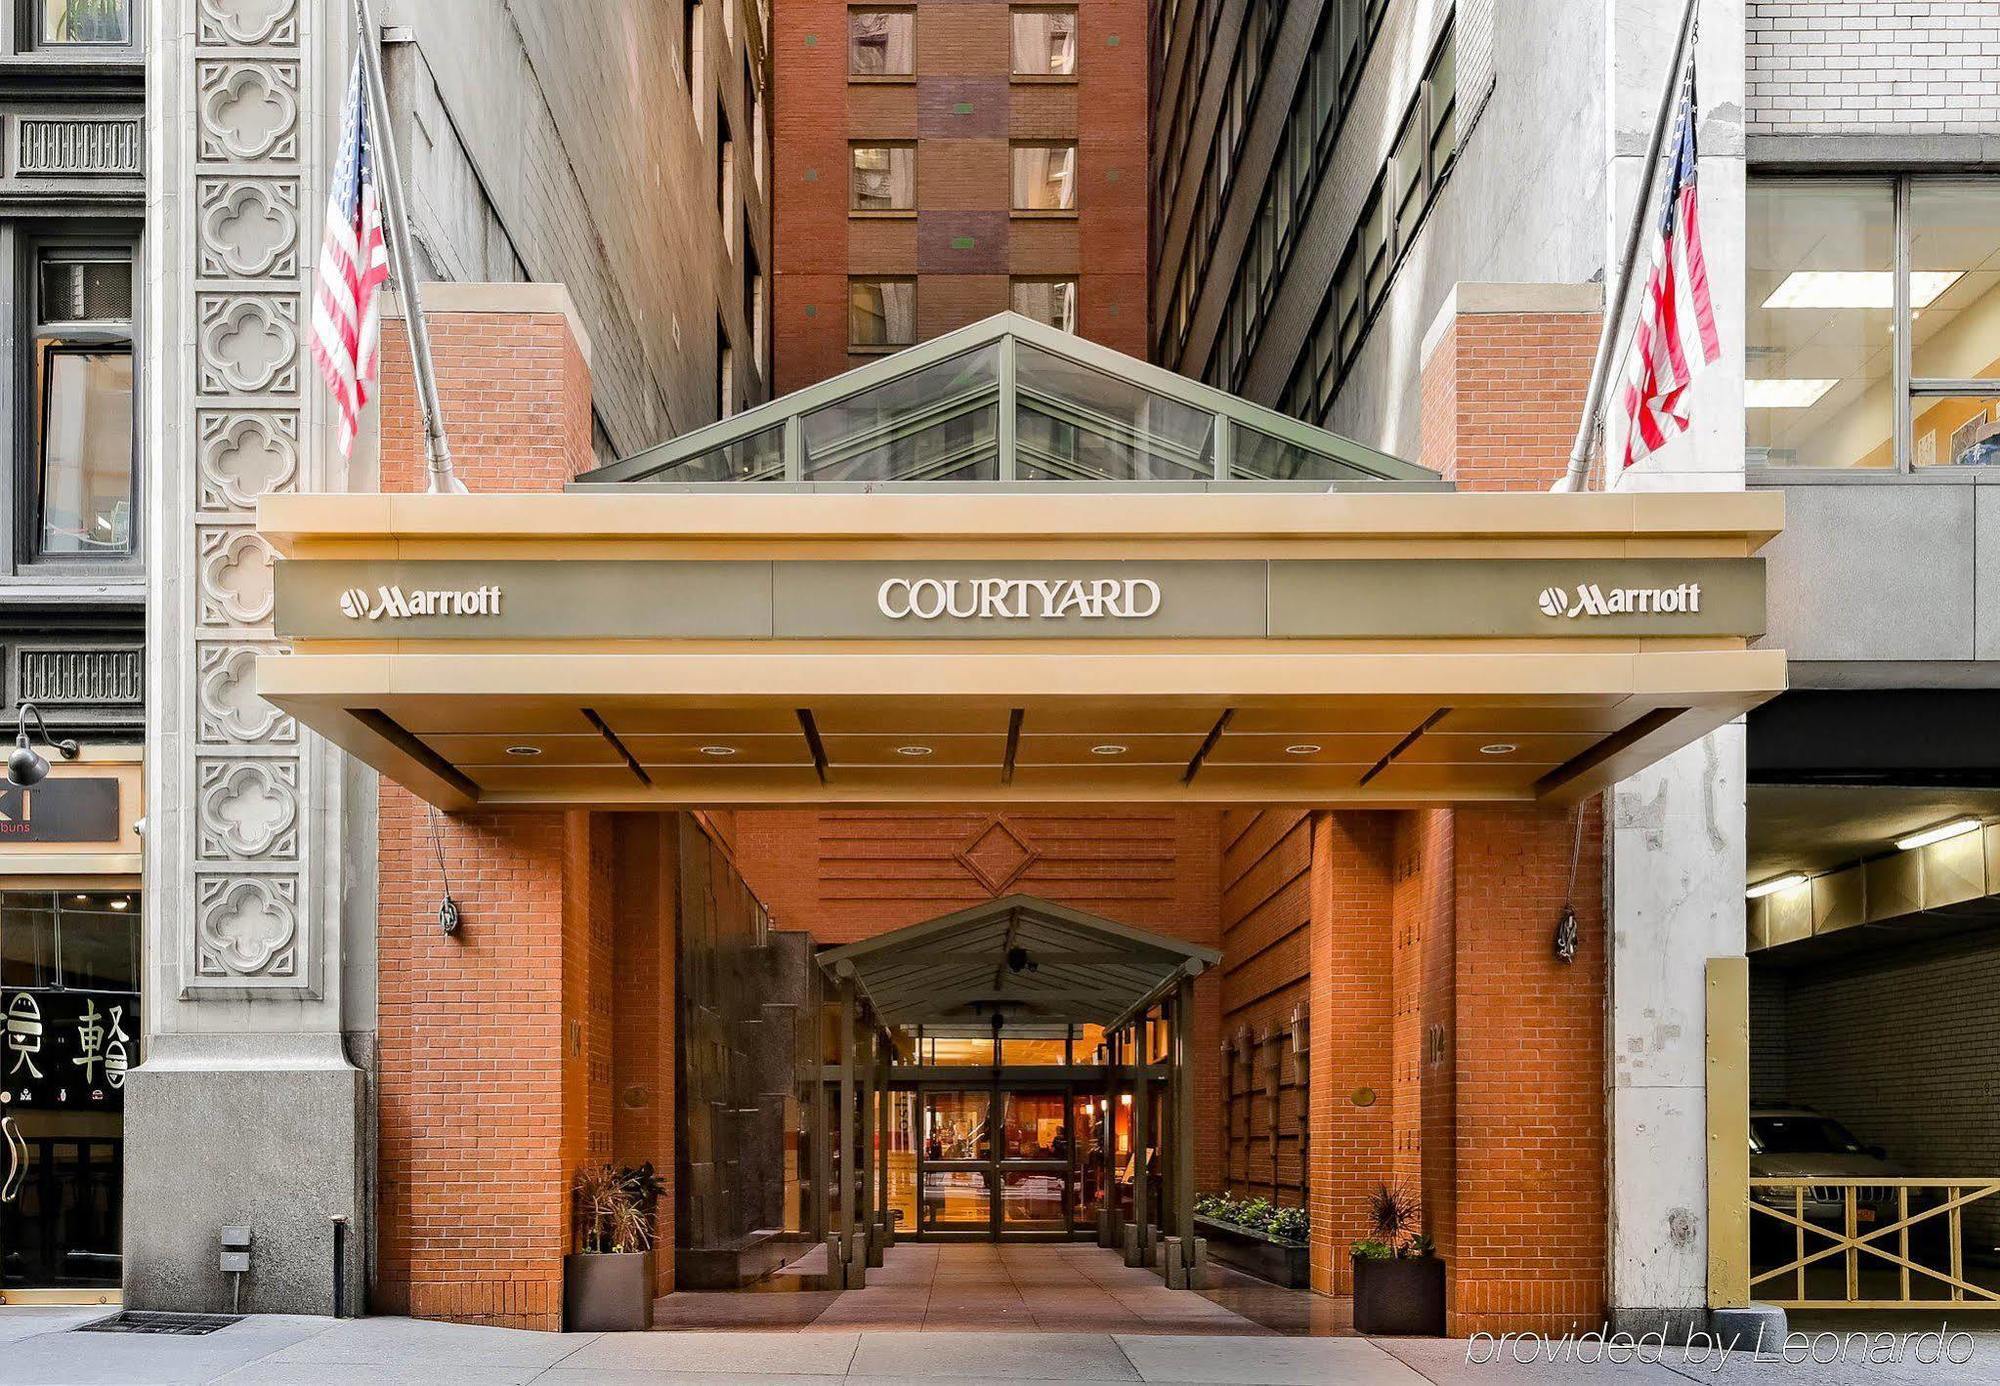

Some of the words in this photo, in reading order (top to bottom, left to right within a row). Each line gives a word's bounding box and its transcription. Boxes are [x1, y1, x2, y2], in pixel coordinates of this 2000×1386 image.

[369, 585, 502, 620] Marriott
[877, 578, 1161, 619] COURTYARD
[1566, 583, 1701, 618] Marriott
[0, 822, 31, 833] buns
